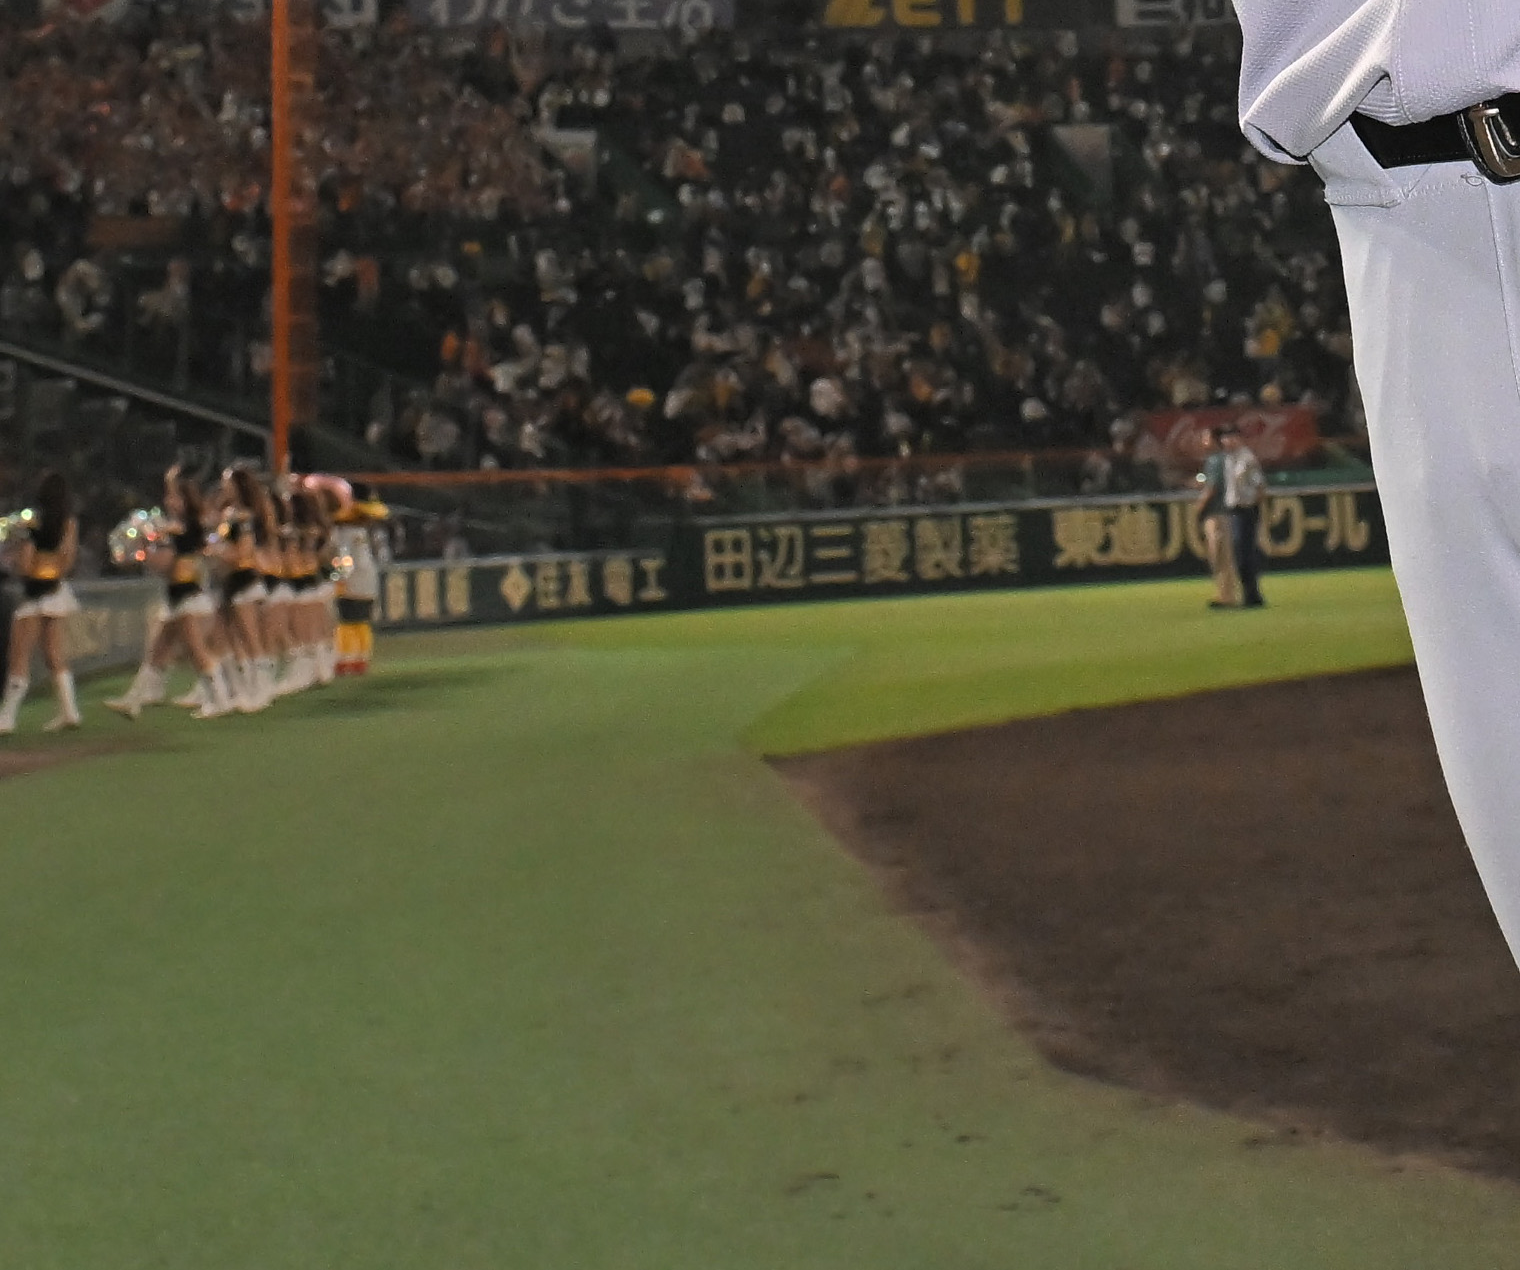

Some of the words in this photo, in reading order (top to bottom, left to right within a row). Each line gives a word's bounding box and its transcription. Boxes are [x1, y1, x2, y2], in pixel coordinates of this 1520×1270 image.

[703, 513, 1020, 593] 田辺三菱製薬
